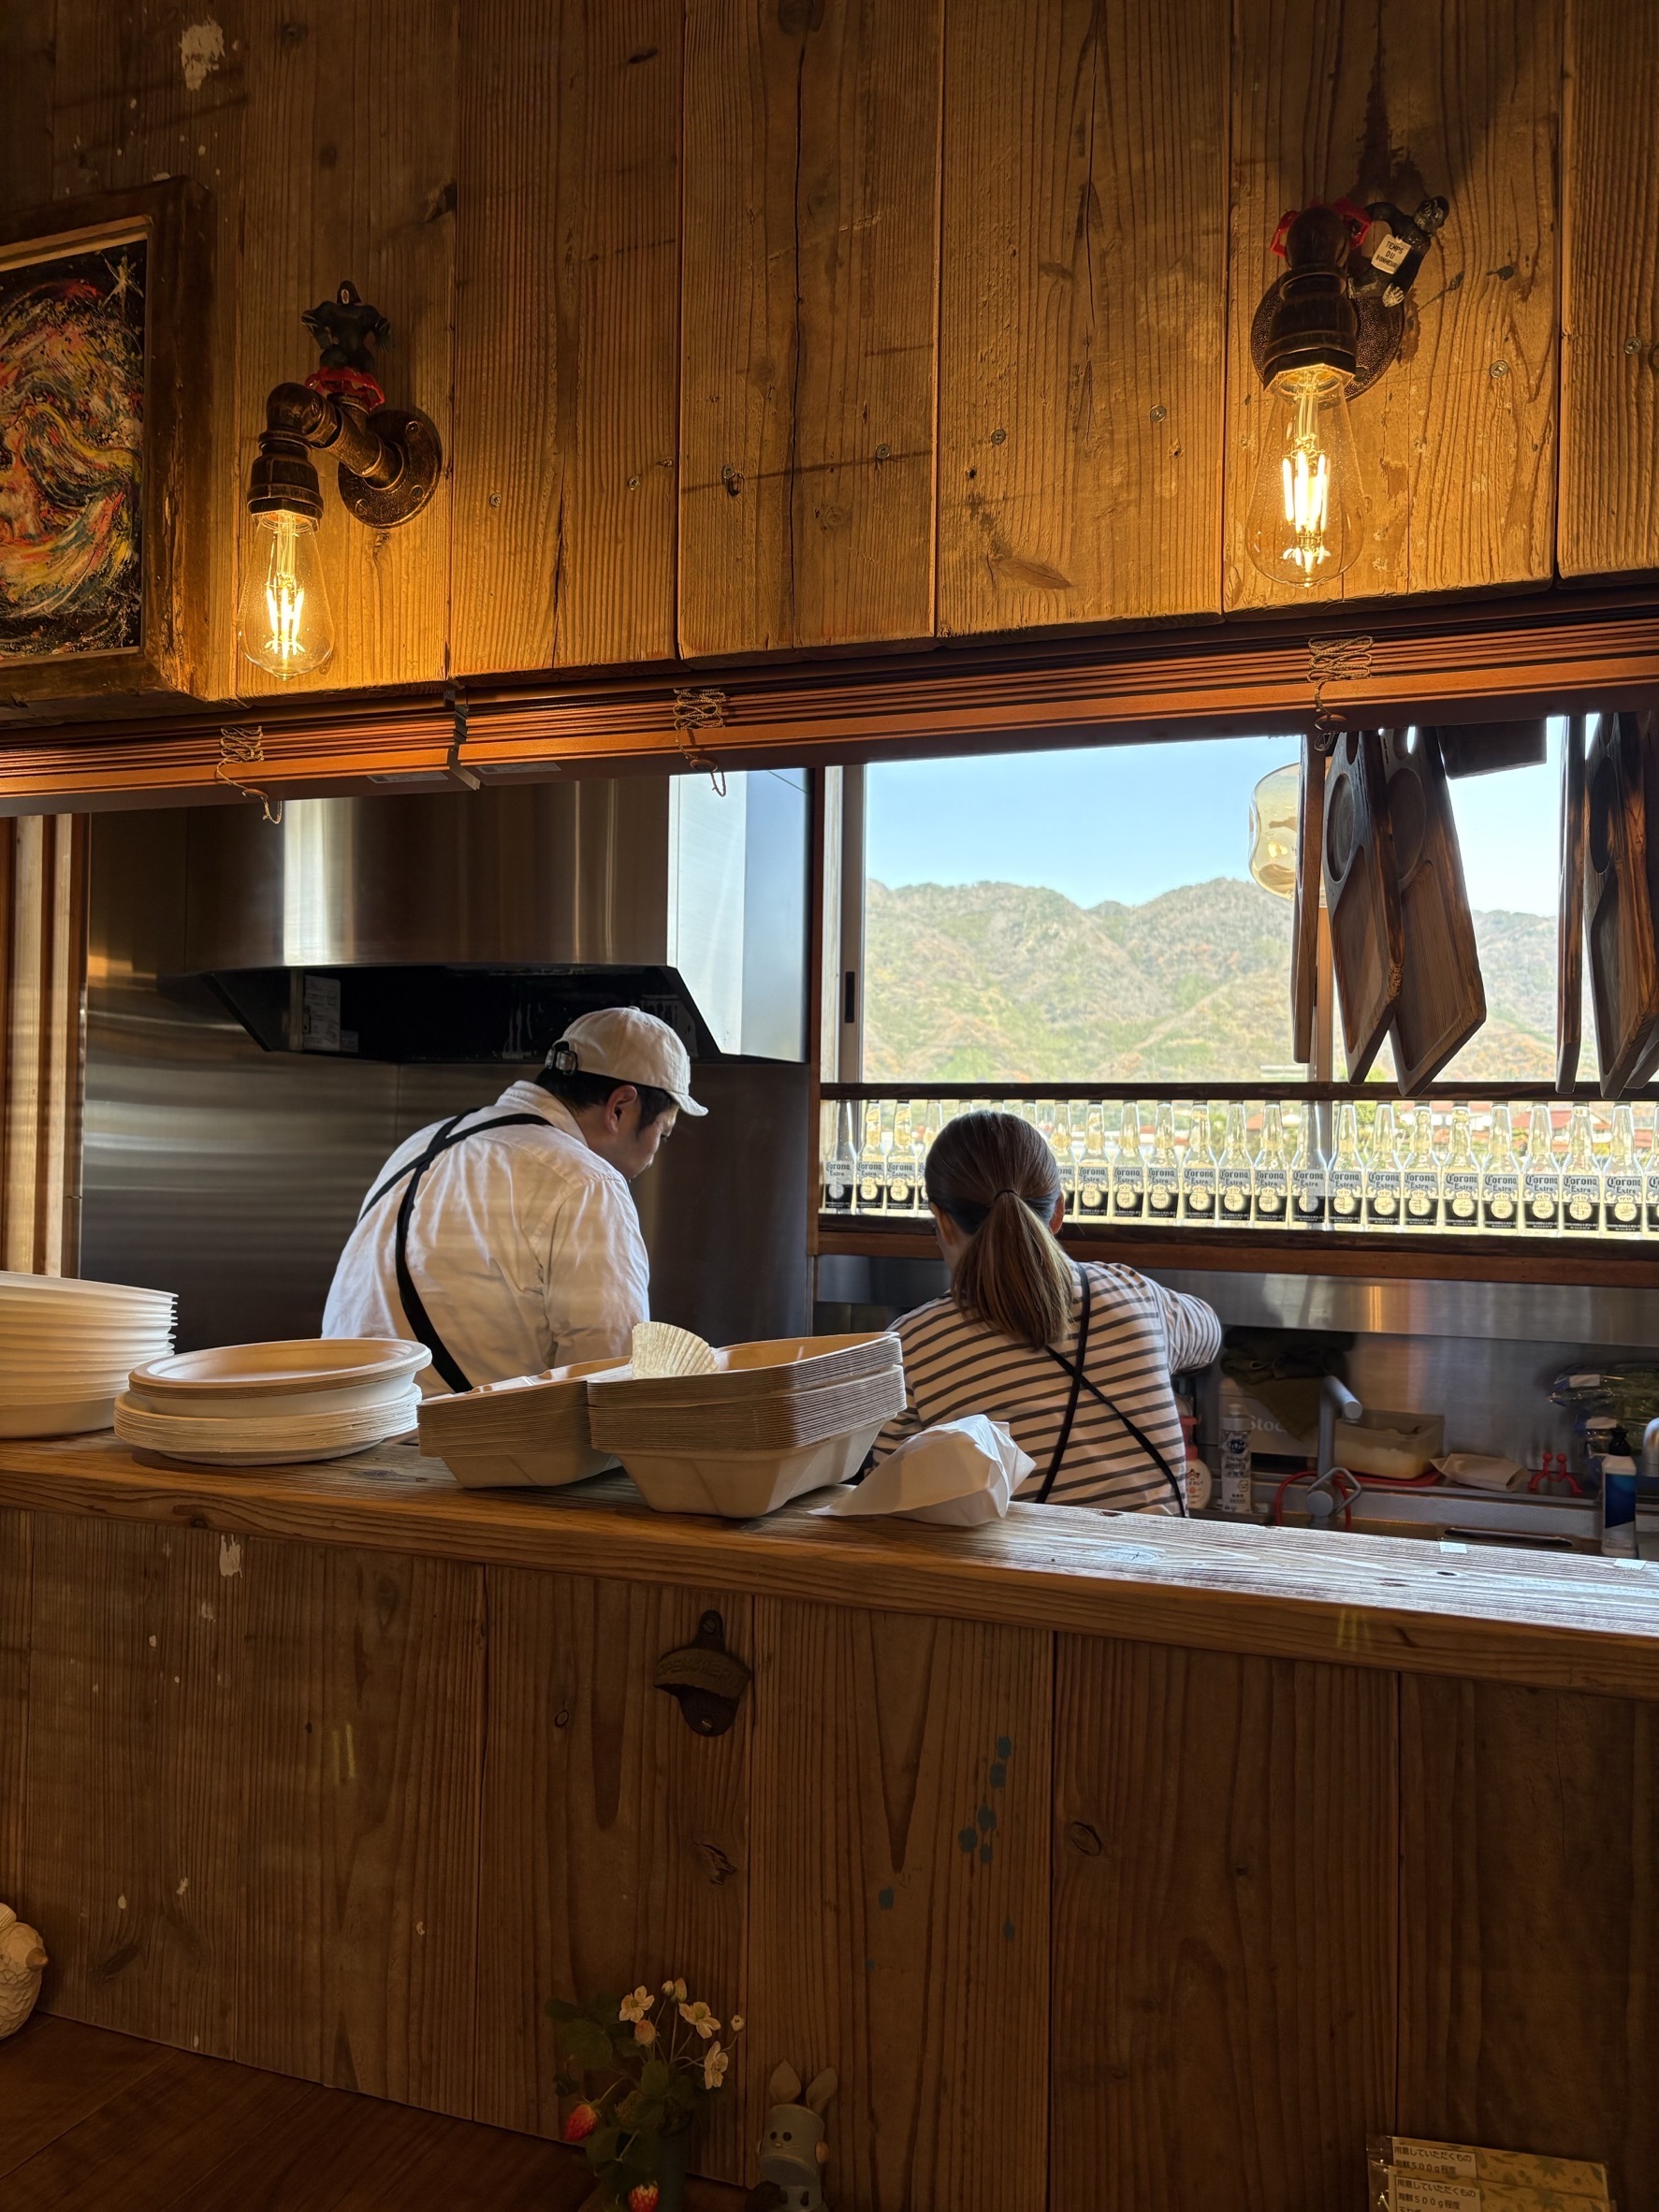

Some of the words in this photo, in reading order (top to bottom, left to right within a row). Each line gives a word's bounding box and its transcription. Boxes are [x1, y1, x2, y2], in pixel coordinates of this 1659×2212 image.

[1386, 240, 1404, 255] TEMPS
[1385, 250, 1396, 259] DU
[826, 1161, 851, 1171] Corona
[857, 1161, 882, 1171] Corona
[888, 1162, 912, 1172] Corona
[1080, 1167, 1105, 1176] Corona
[1114, 1168, 1141, 1177] Corona
[1148, 1168, 1175, 1178] Corona
[1184, 1169, 1214, 1179] Corona
[1219, 1169, 1248, 1180] Corona
[1256, 1171, 1284, 1182] Corona
[1293, 1171, 1324, 1182] Corona
[1329, 1171, 1360, 1183] Corona
[1368, 1171, 1399, 1184] Corona
[1404, 1172, 1435, 1185] Corona
[1446, 1173, 1477, 1186] Corona
[1484, 1174, 1517, 1186] Corona
[1525, 1174, 1558, 1186] Corona
[1563, 1176, 1597, 1187] Corona
[1607, 1176, 1641, 1188] Corona
[1259, 1179, 1278, 1187] Extra
[1300, 1179, 1318, 1187] Extra
[1335, 1180, 1353, 1188] Extra
[1375, 1181, 1394, 1189] Extra
[1492, 1184, 1512, 1192] Extra
[1534, 1184, 1553, 1192] Extra
[1571, 1185, 1591, 1193] Extra
[1616, 1186, 1637, 1194] Extra
[1394, 2146, 1472, 2162] 用意していただくもの
[1397, 2178, 1476, 2198] 用意していただくもの
